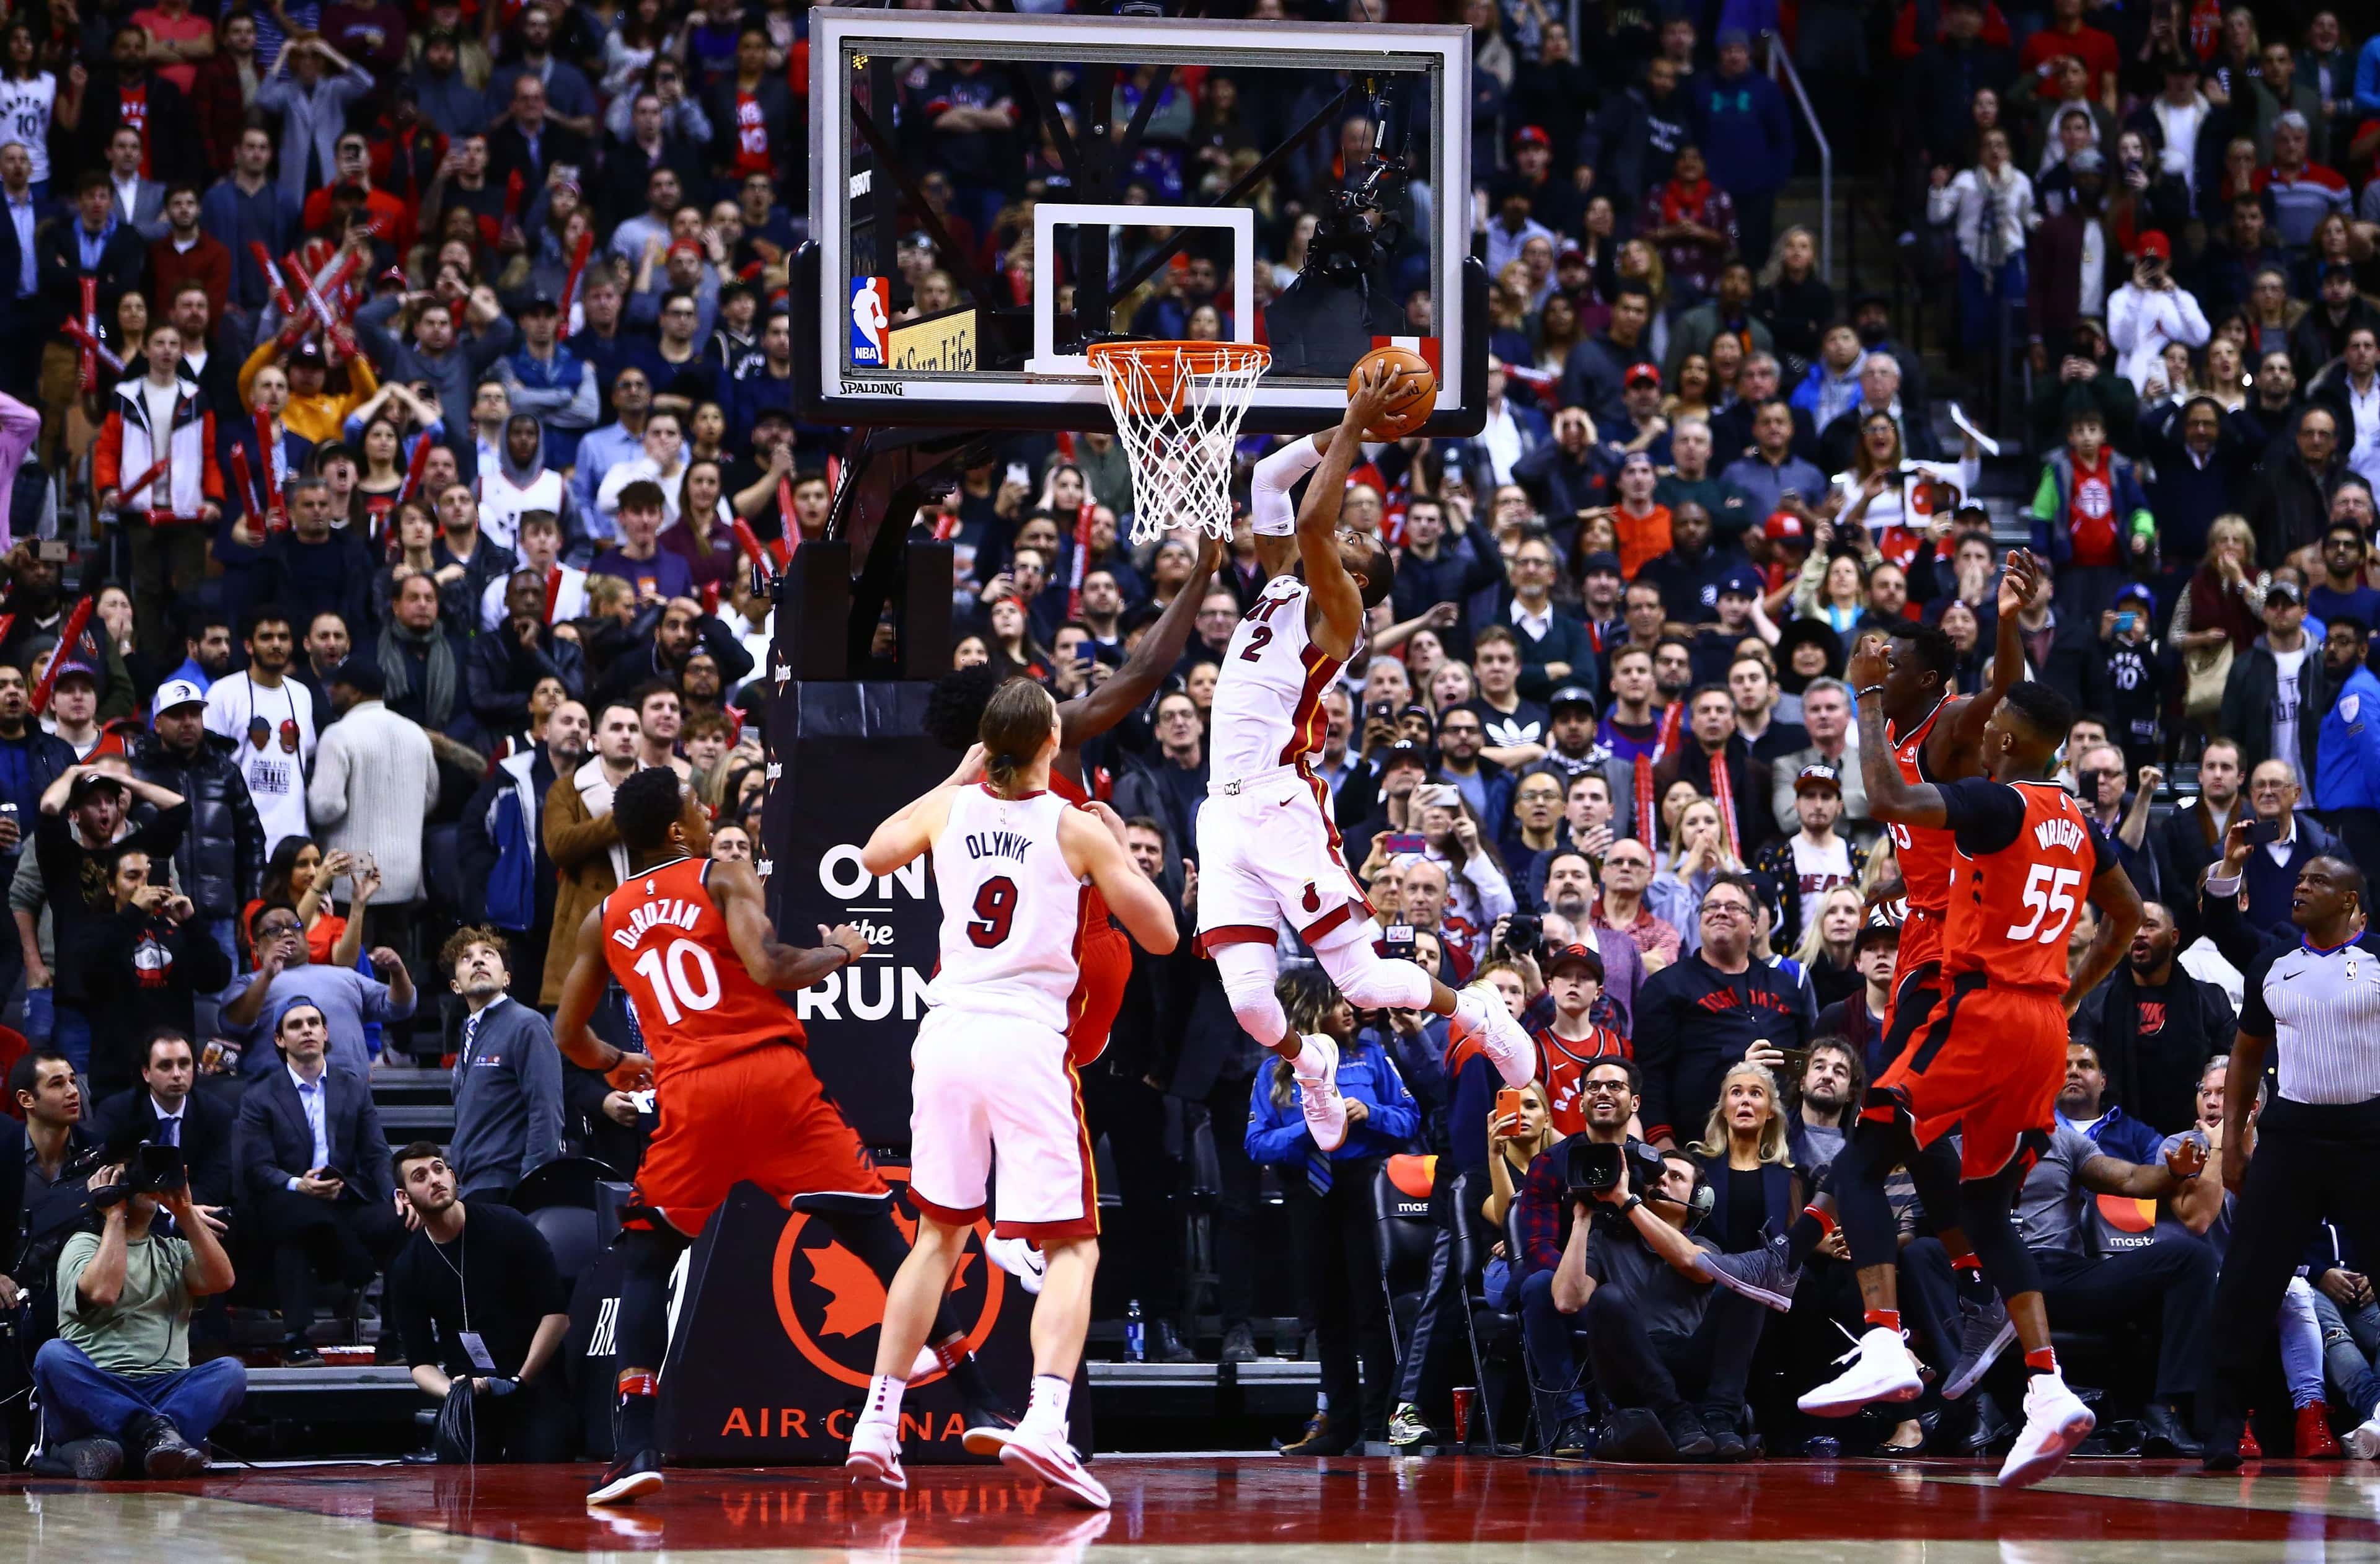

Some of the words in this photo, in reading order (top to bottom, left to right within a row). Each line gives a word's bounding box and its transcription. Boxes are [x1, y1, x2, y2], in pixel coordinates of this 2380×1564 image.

[855, 347, 877, 360] NBA
[840, 381, 904, 397] SPALDING
[1240, 625, 1273, 663] 2
[966, 831, 1033, 864] OLYNYK
[2034, 818, 2084, 855] WRIGHT
[819, 844, 925, 899] ON
[966, 875, 1018, 949] 9
[2006, 863, 2082, 944] 55
[633, 938, 721, 1025] 10
[721, 1407, 809, 1438] AIR
